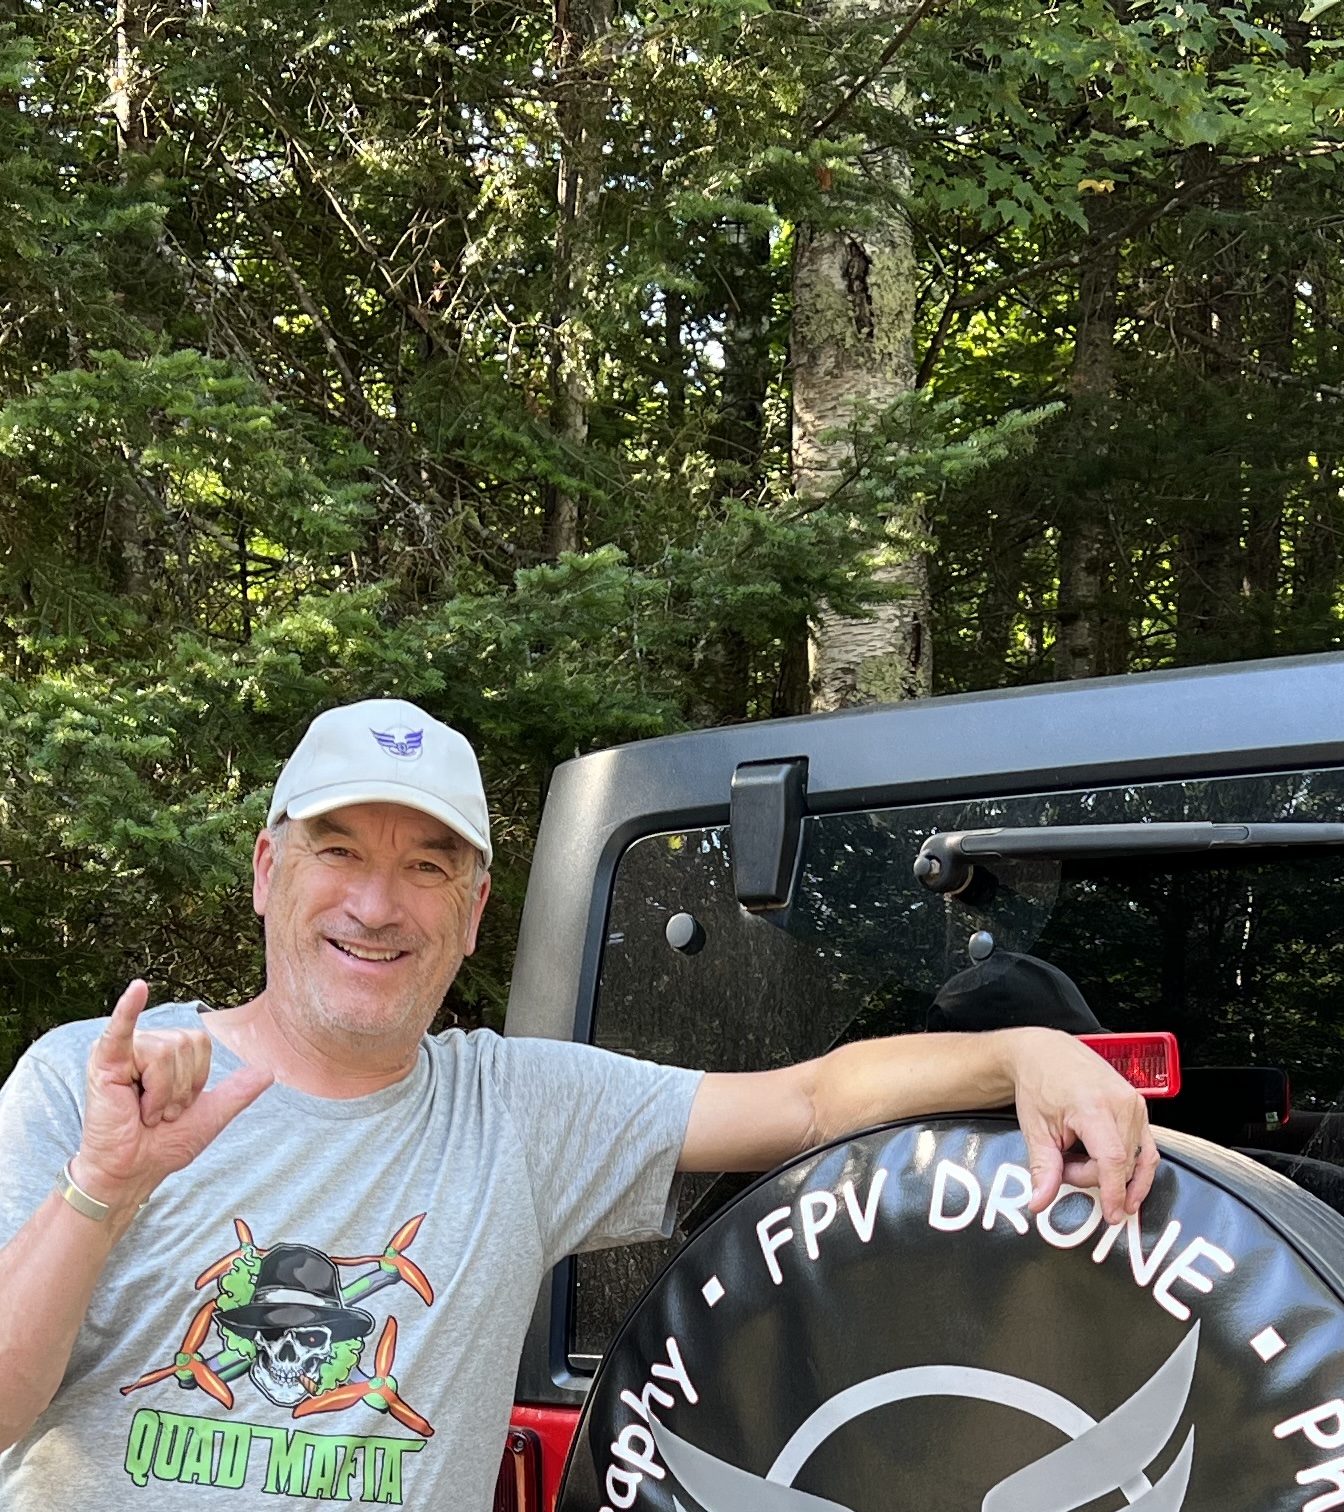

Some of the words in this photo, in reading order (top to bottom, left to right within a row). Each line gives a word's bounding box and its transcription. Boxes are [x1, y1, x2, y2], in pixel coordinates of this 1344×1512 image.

[755, 1167, 890, 1285] FPV
[926, 1158, 1236, 1322] DRONE
[124, 1408, 252, 1489] QUAD
[253, 1427, 427, 1505] MAFIA
